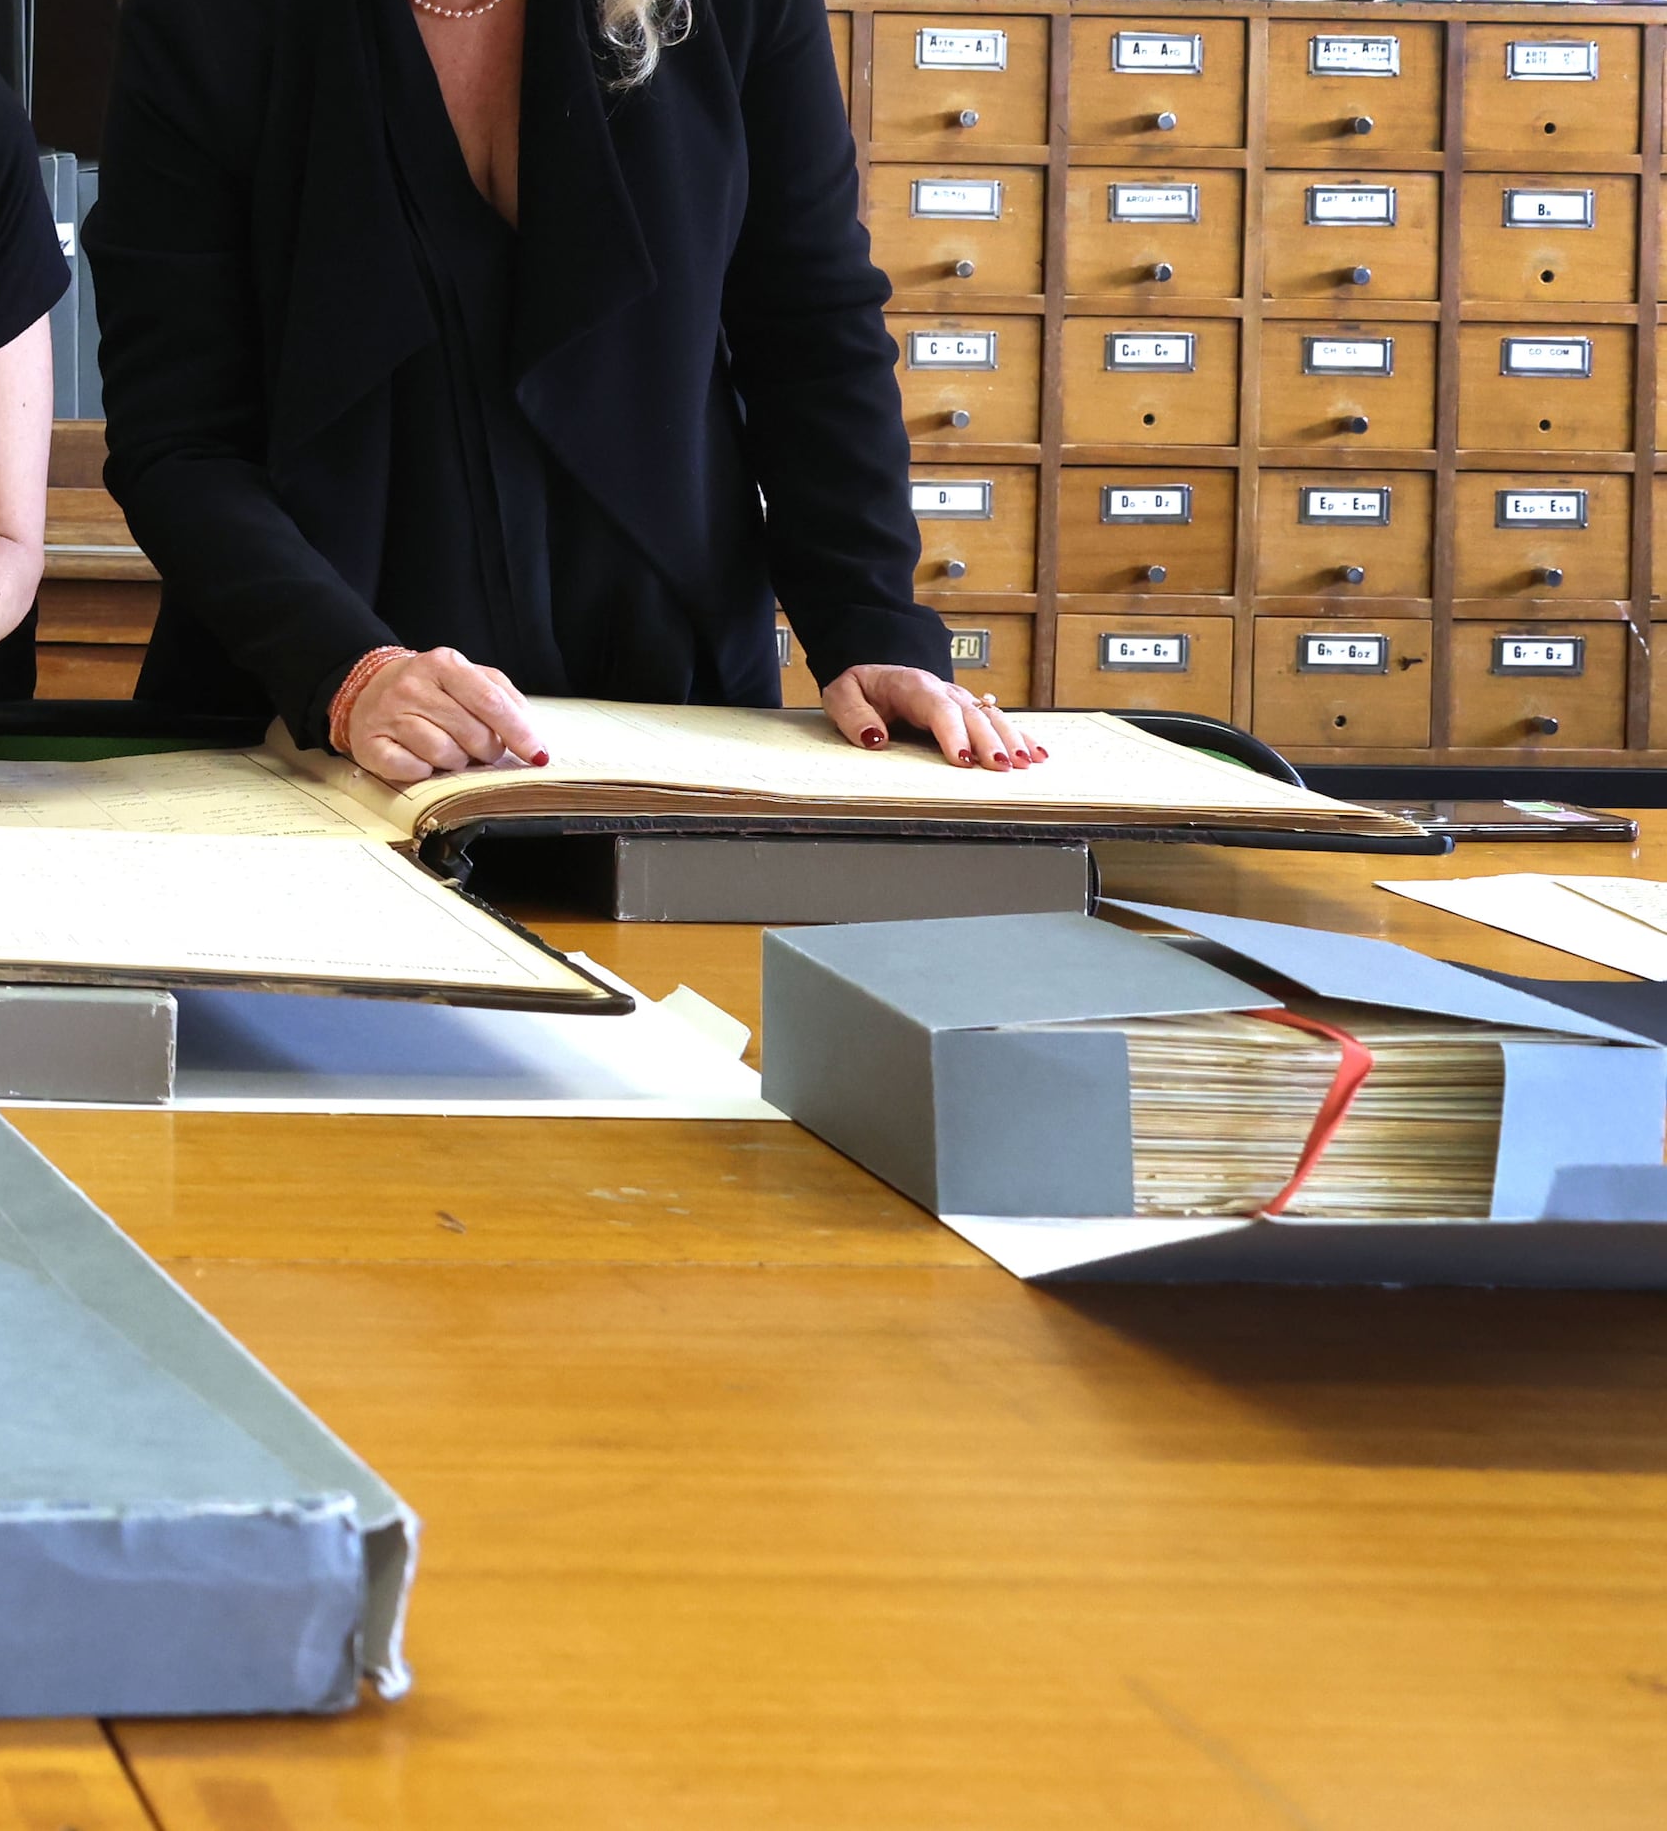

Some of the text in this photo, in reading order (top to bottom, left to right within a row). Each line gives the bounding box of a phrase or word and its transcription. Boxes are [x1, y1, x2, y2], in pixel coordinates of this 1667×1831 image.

[931, 342, 937, 354] C
[1318, 497, 1375, 513] Ep Esm
[1514, 500, 1570, 516] Esp Ess
